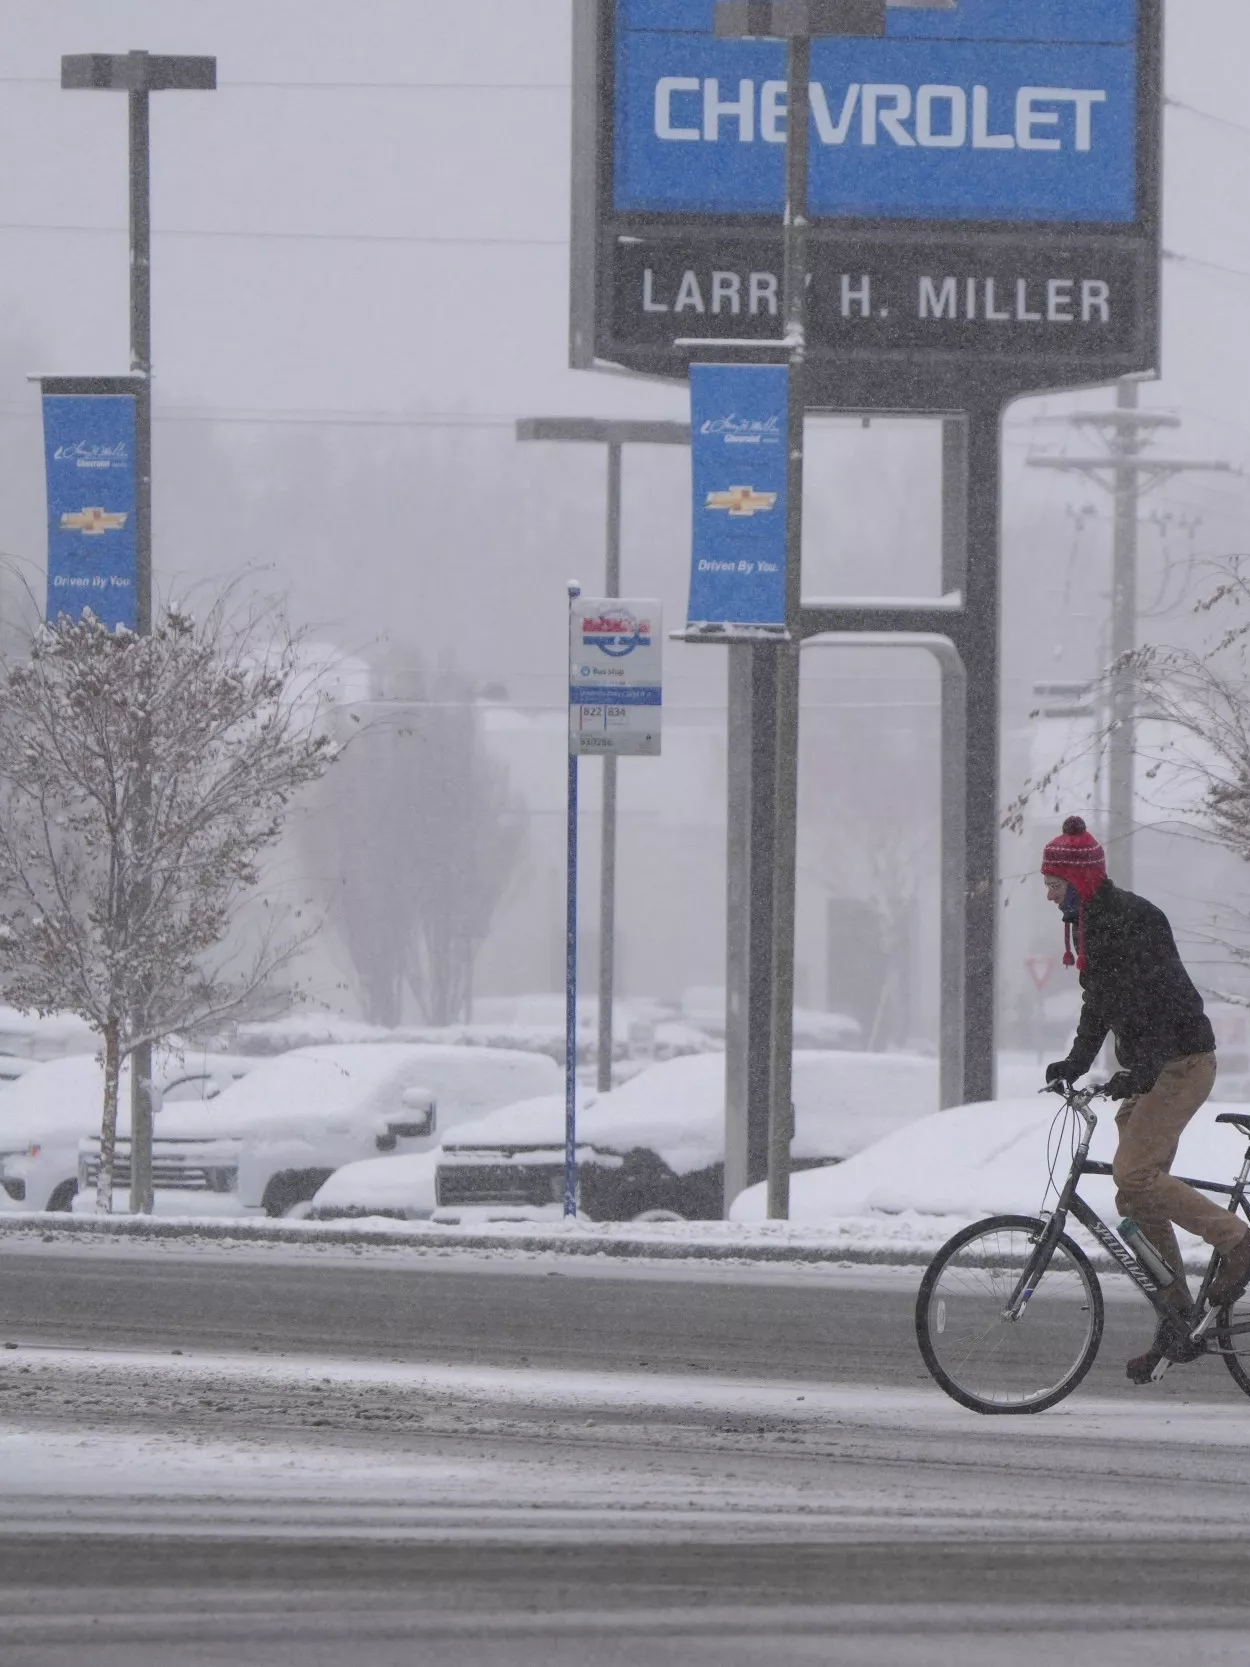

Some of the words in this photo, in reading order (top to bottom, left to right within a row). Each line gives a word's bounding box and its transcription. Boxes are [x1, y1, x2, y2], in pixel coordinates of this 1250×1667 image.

[653, 75, 1107, 152] CHEVROLET
[642, 268, 813, 315] LARR
[840, 274, 888, 318] H.
[918, 275, 1111, 323] MILLER
[55, 575, 90, 587] Driven
[698, 559, 735, 571] Driven
[737, 560, 754, 574] By
